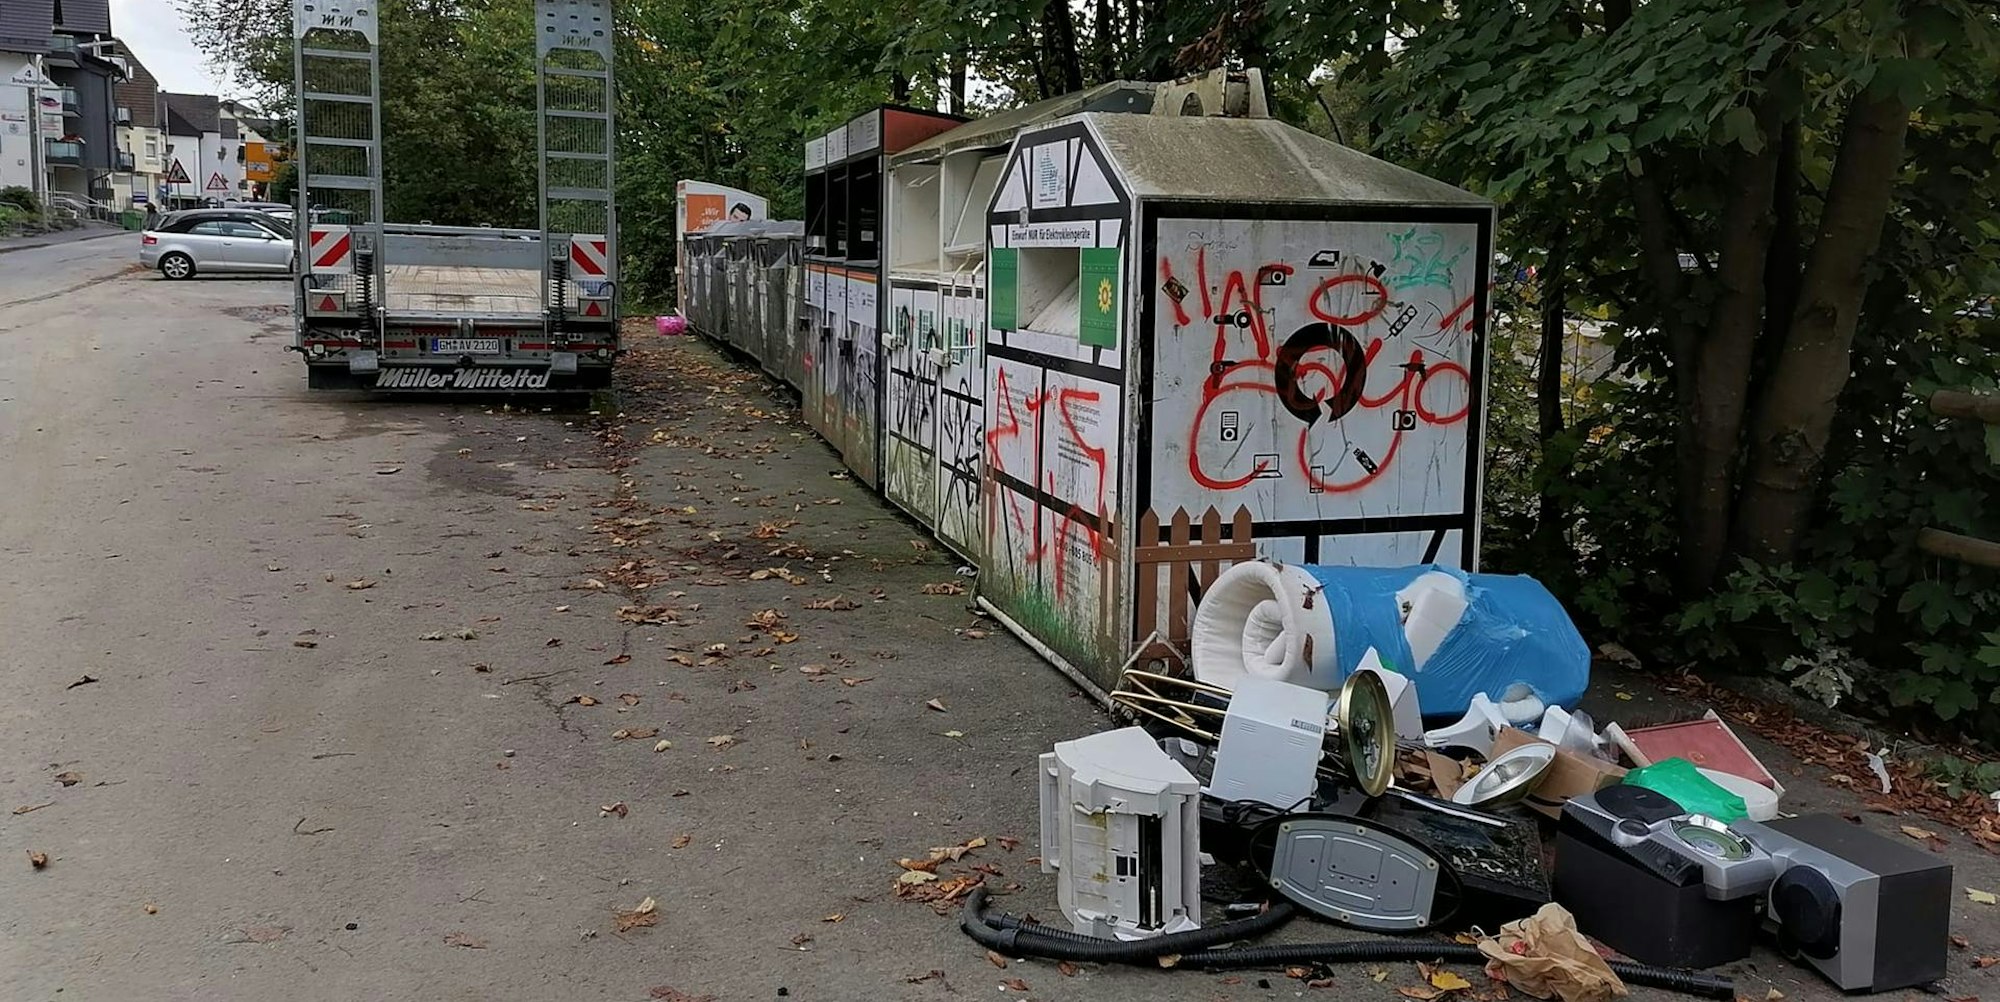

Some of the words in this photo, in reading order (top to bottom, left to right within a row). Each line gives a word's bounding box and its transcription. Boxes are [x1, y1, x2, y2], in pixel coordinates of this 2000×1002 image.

[25, 69, 32, 78] 4
[473, 340, 498, 350] 2120
[375, 368, 453, 388] Müller
[453, 367, 551, 389] Mitteltal
